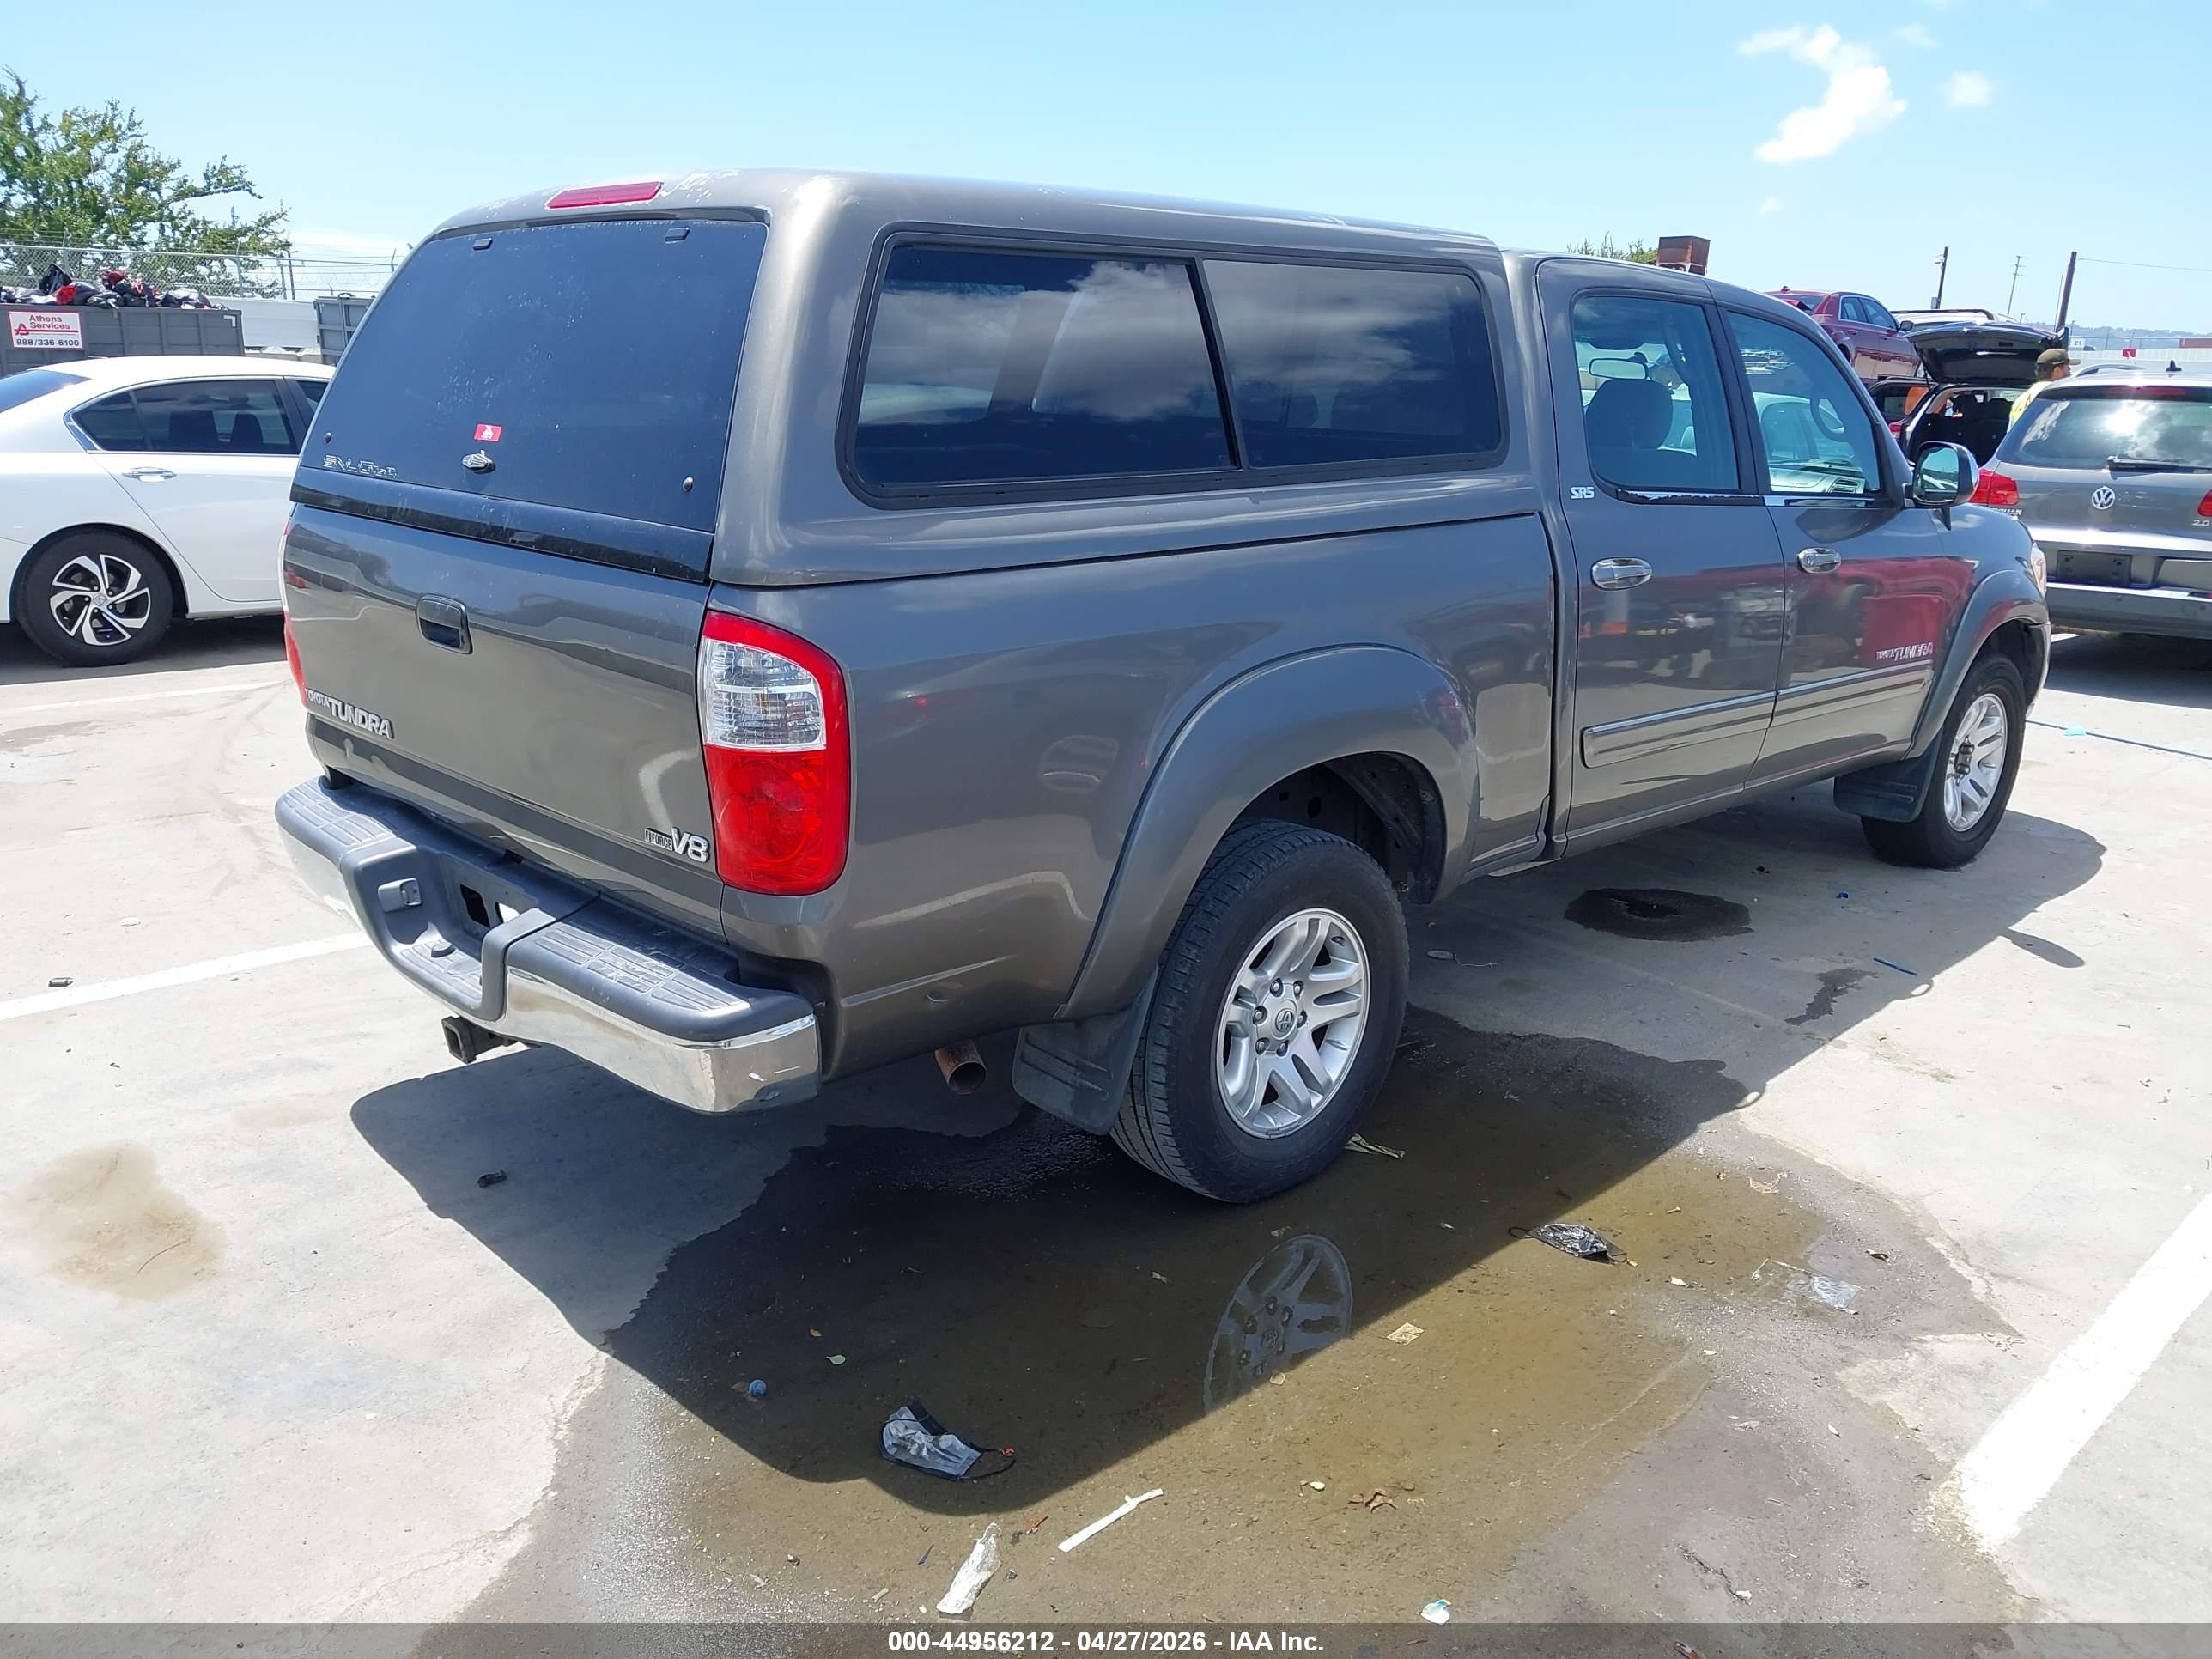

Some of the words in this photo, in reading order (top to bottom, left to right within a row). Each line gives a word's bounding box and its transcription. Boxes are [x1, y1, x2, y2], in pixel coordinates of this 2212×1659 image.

[29, 314, 63, 323] Athens
[29, 321, 70, 330] Services
[15, 338, 80, 347] 888/336-6100
[1570, 486, 1595, 500] SR5
[1893, 641, 1934, 662] TUNDRA
[304, 687, 331, 708] TOYOTA
[328, 696, 393, 740] TUNDRA
[672, 826, 709, 863] V8
